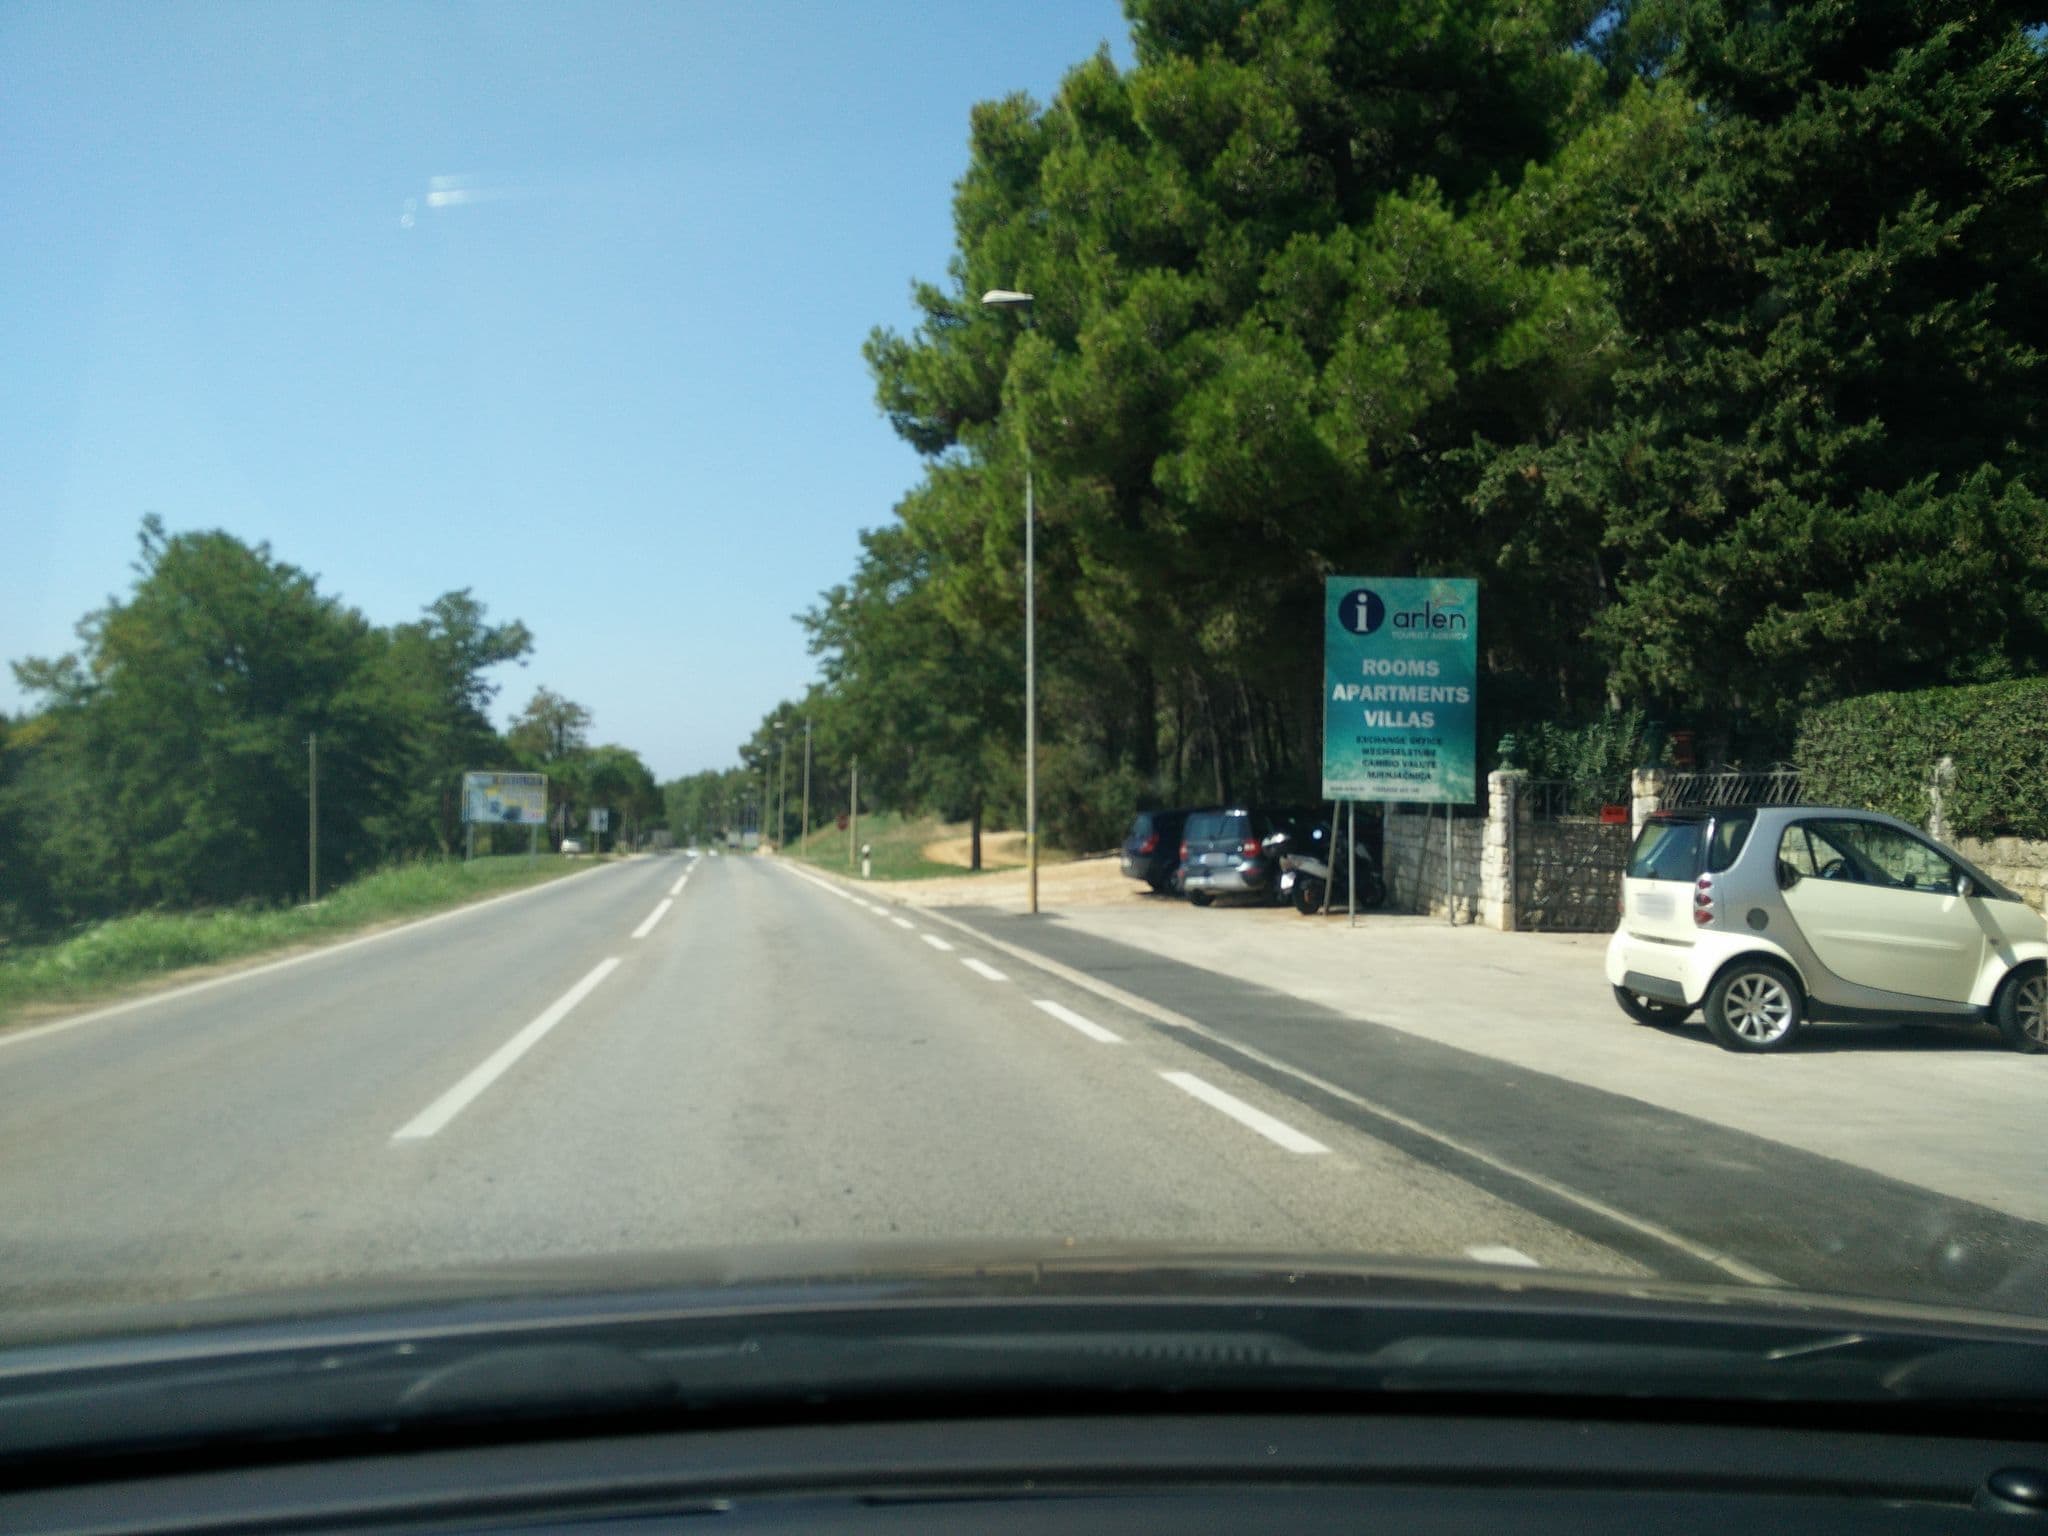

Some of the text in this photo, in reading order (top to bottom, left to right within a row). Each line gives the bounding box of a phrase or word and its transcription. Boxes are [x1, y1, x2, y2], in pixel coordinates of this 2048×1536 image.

[1393, 600, 1466, 630] arlen
[1362, 659, 1440, 677] ROOMS
[1332, 684, 1471, 703] APARTMENTS
[1364, 710, 1435, 728] VILLAS
